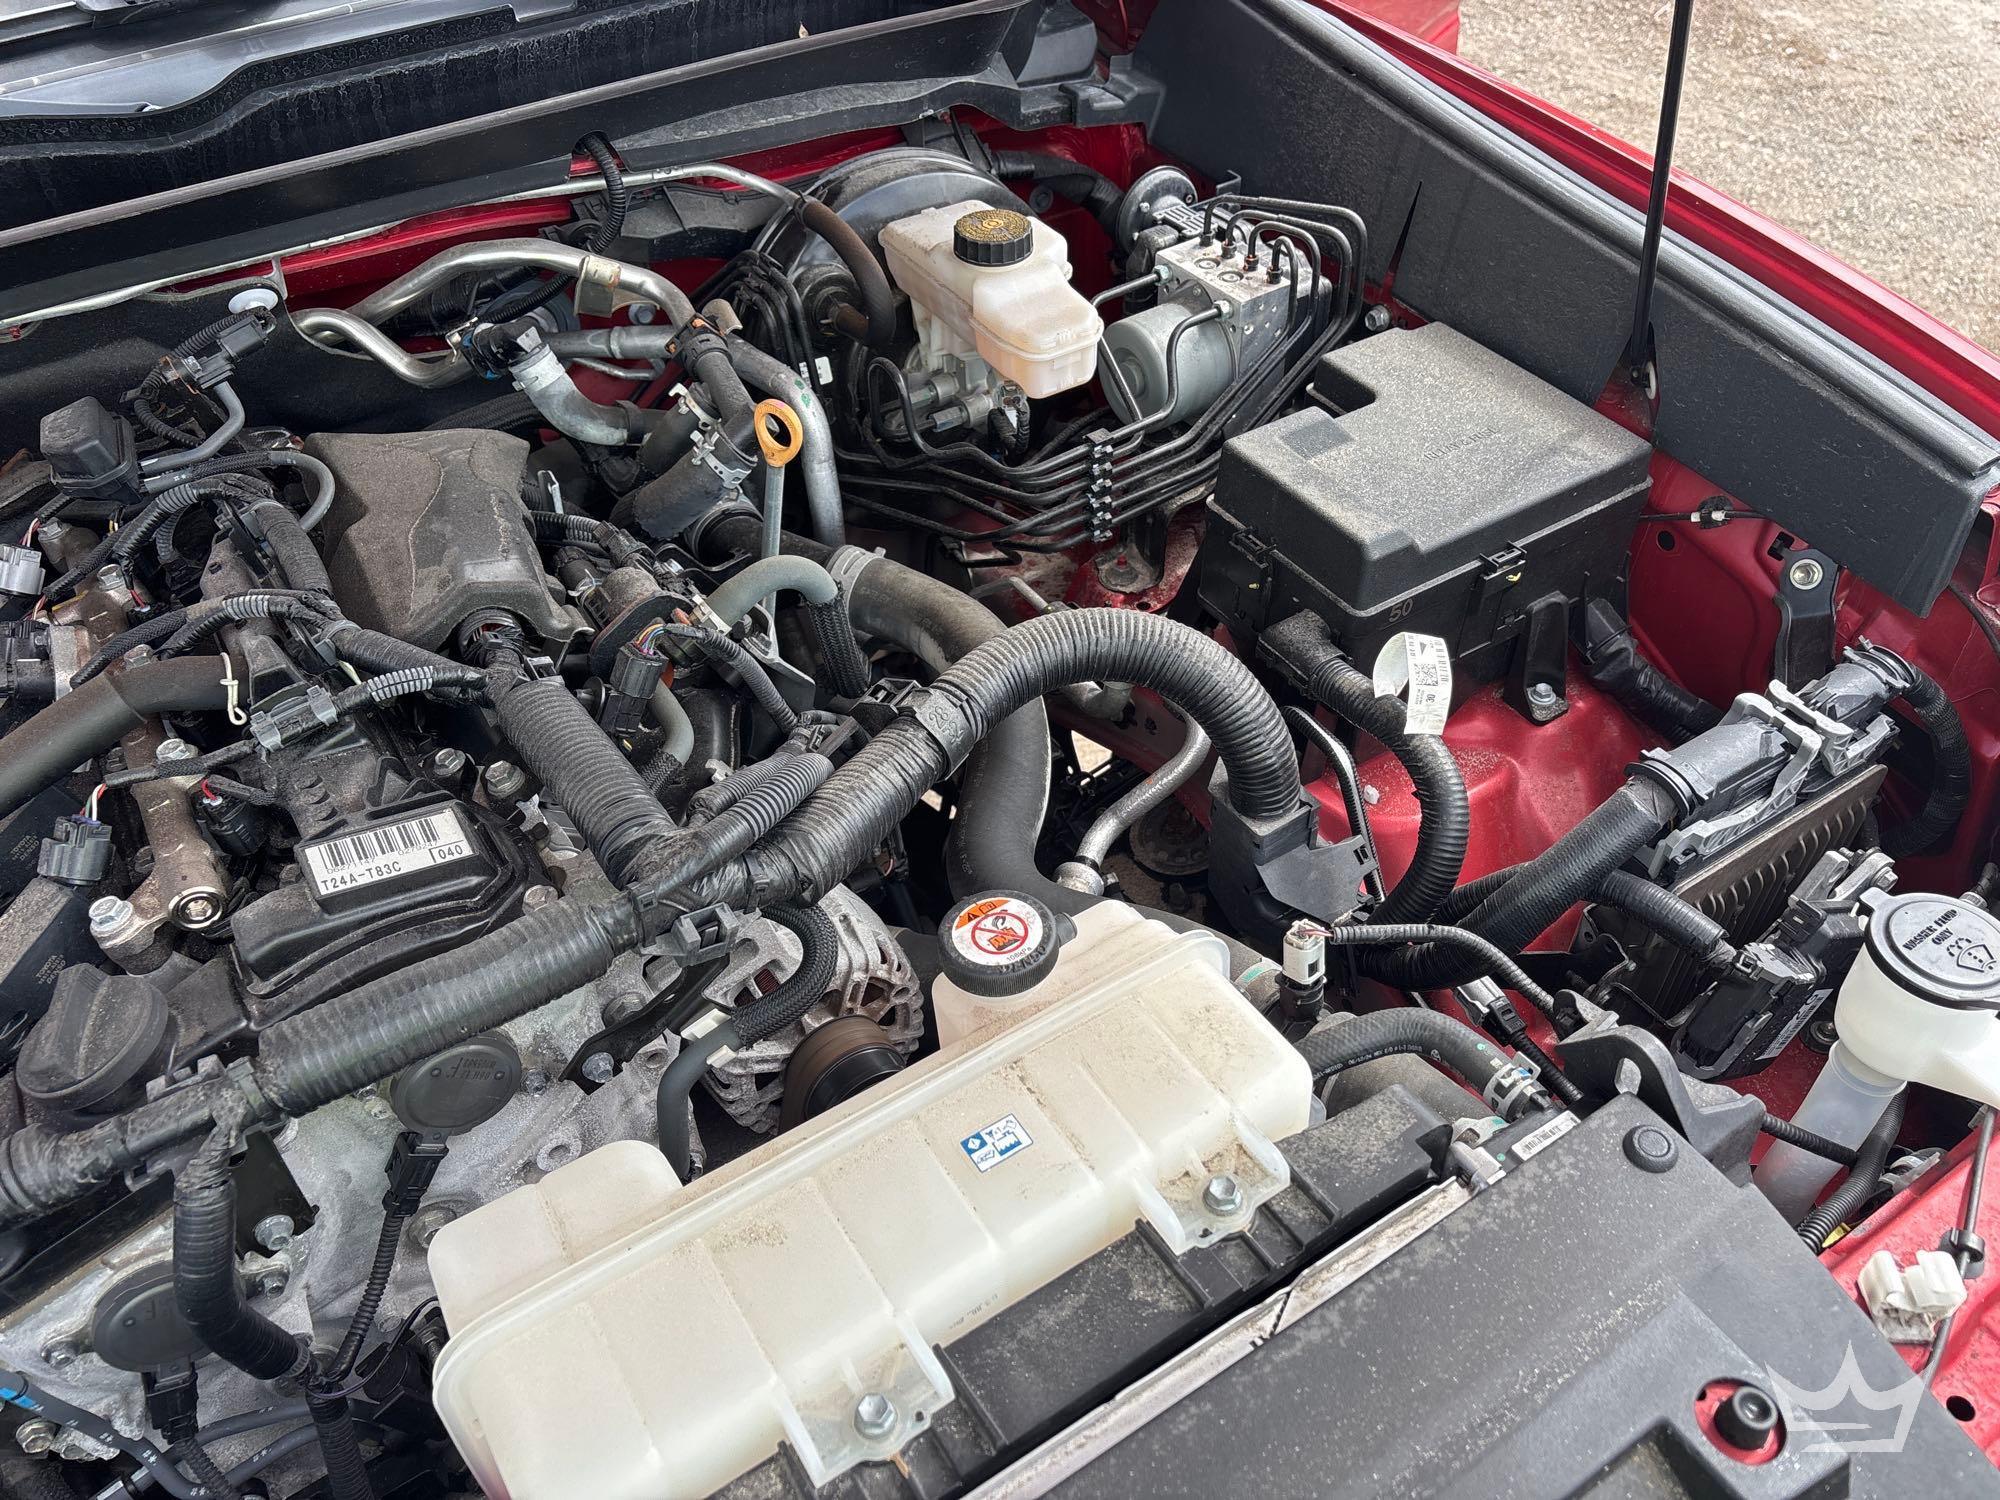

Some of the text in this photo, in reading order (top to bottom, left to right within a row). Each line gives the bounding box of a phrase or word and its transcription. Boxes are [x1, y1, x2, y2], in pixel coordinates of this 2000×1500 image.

[1389, 599, 1413, 622] 50
[929, 706, 949, 729] 28
[10, 836, 31, 854] TOYOTA
[20, 840, 39, 860] DENSO
[321, 844, 463, 891] T24A-T83C 040
[1902, 925, 1937, 950] WASHER
[1932, 928, 1953, 945] ONLY
[36, 955, 57, 977] TOYOTA
